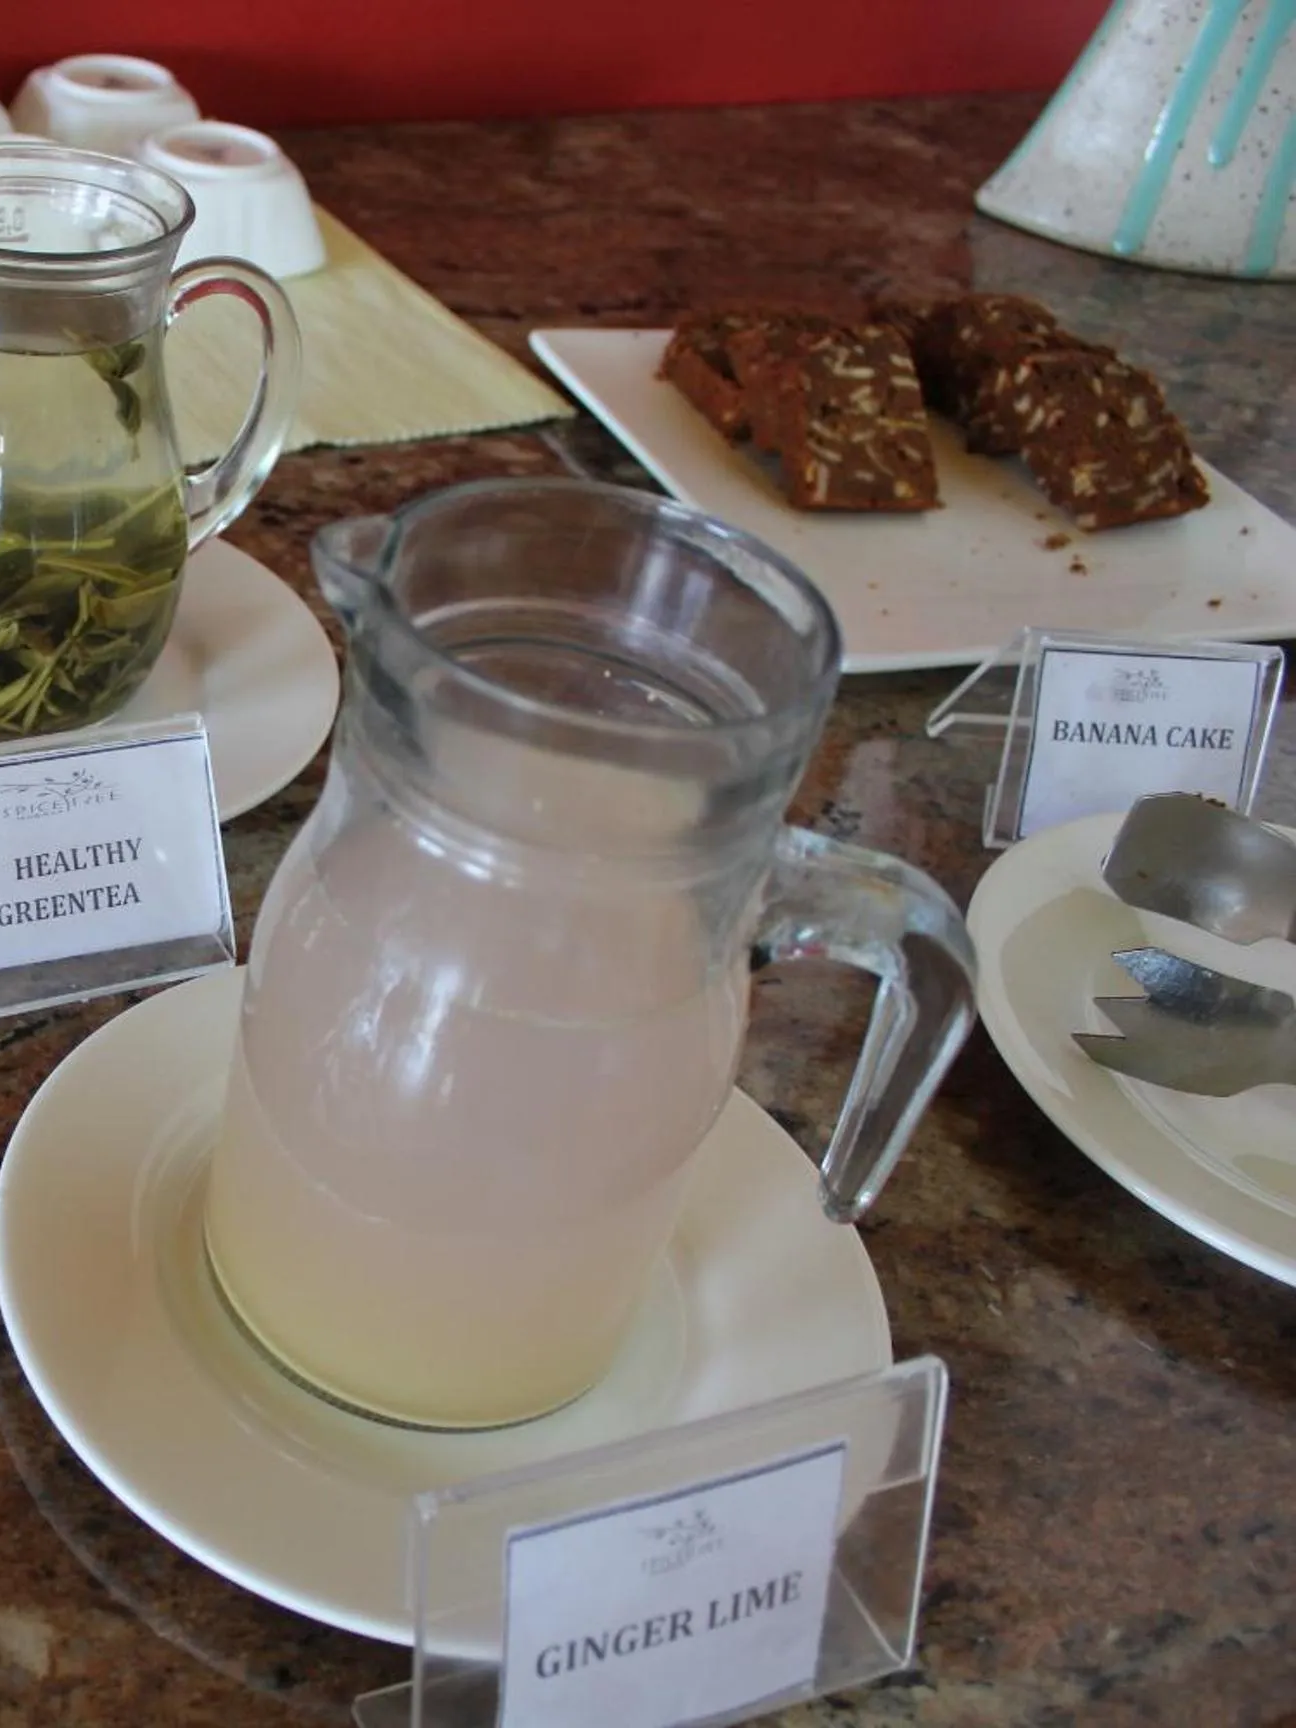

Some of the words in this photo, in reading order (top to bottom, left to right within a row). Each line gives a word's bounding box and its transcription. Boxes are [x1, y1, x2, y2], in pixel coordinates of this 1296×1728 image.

[1053, 719, 1158, 747] BANANA
[1166, 726, 1235, 750] CAKE
[14, 838, 142, 880] HEALTHY
[535, 1610, 694, 1680] GINGER
[707, 1570, 802, 1631] LIME
